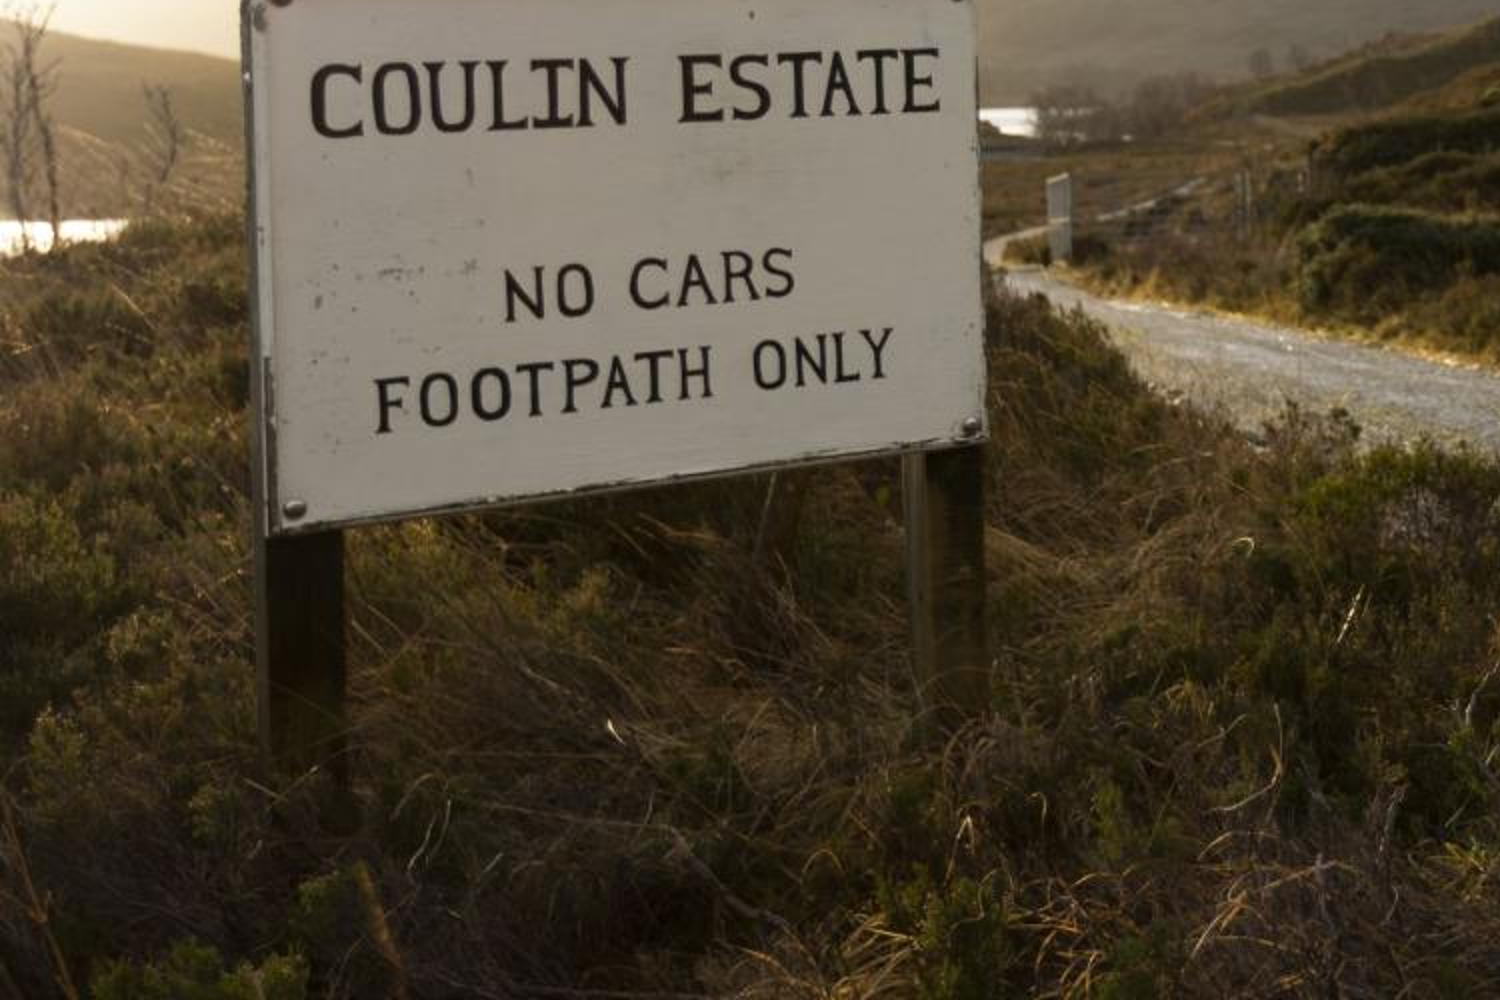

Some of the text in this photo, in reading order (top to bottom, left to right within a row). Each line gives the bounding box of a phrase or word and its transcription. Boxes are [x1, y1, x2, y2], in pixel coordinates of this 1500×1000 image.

[309, 47, 941, 139] COULIN ESTATE
[503, 247, 795, 323] NO CARS
[373, 327, 894, 435] FOOTPATH ONLY
